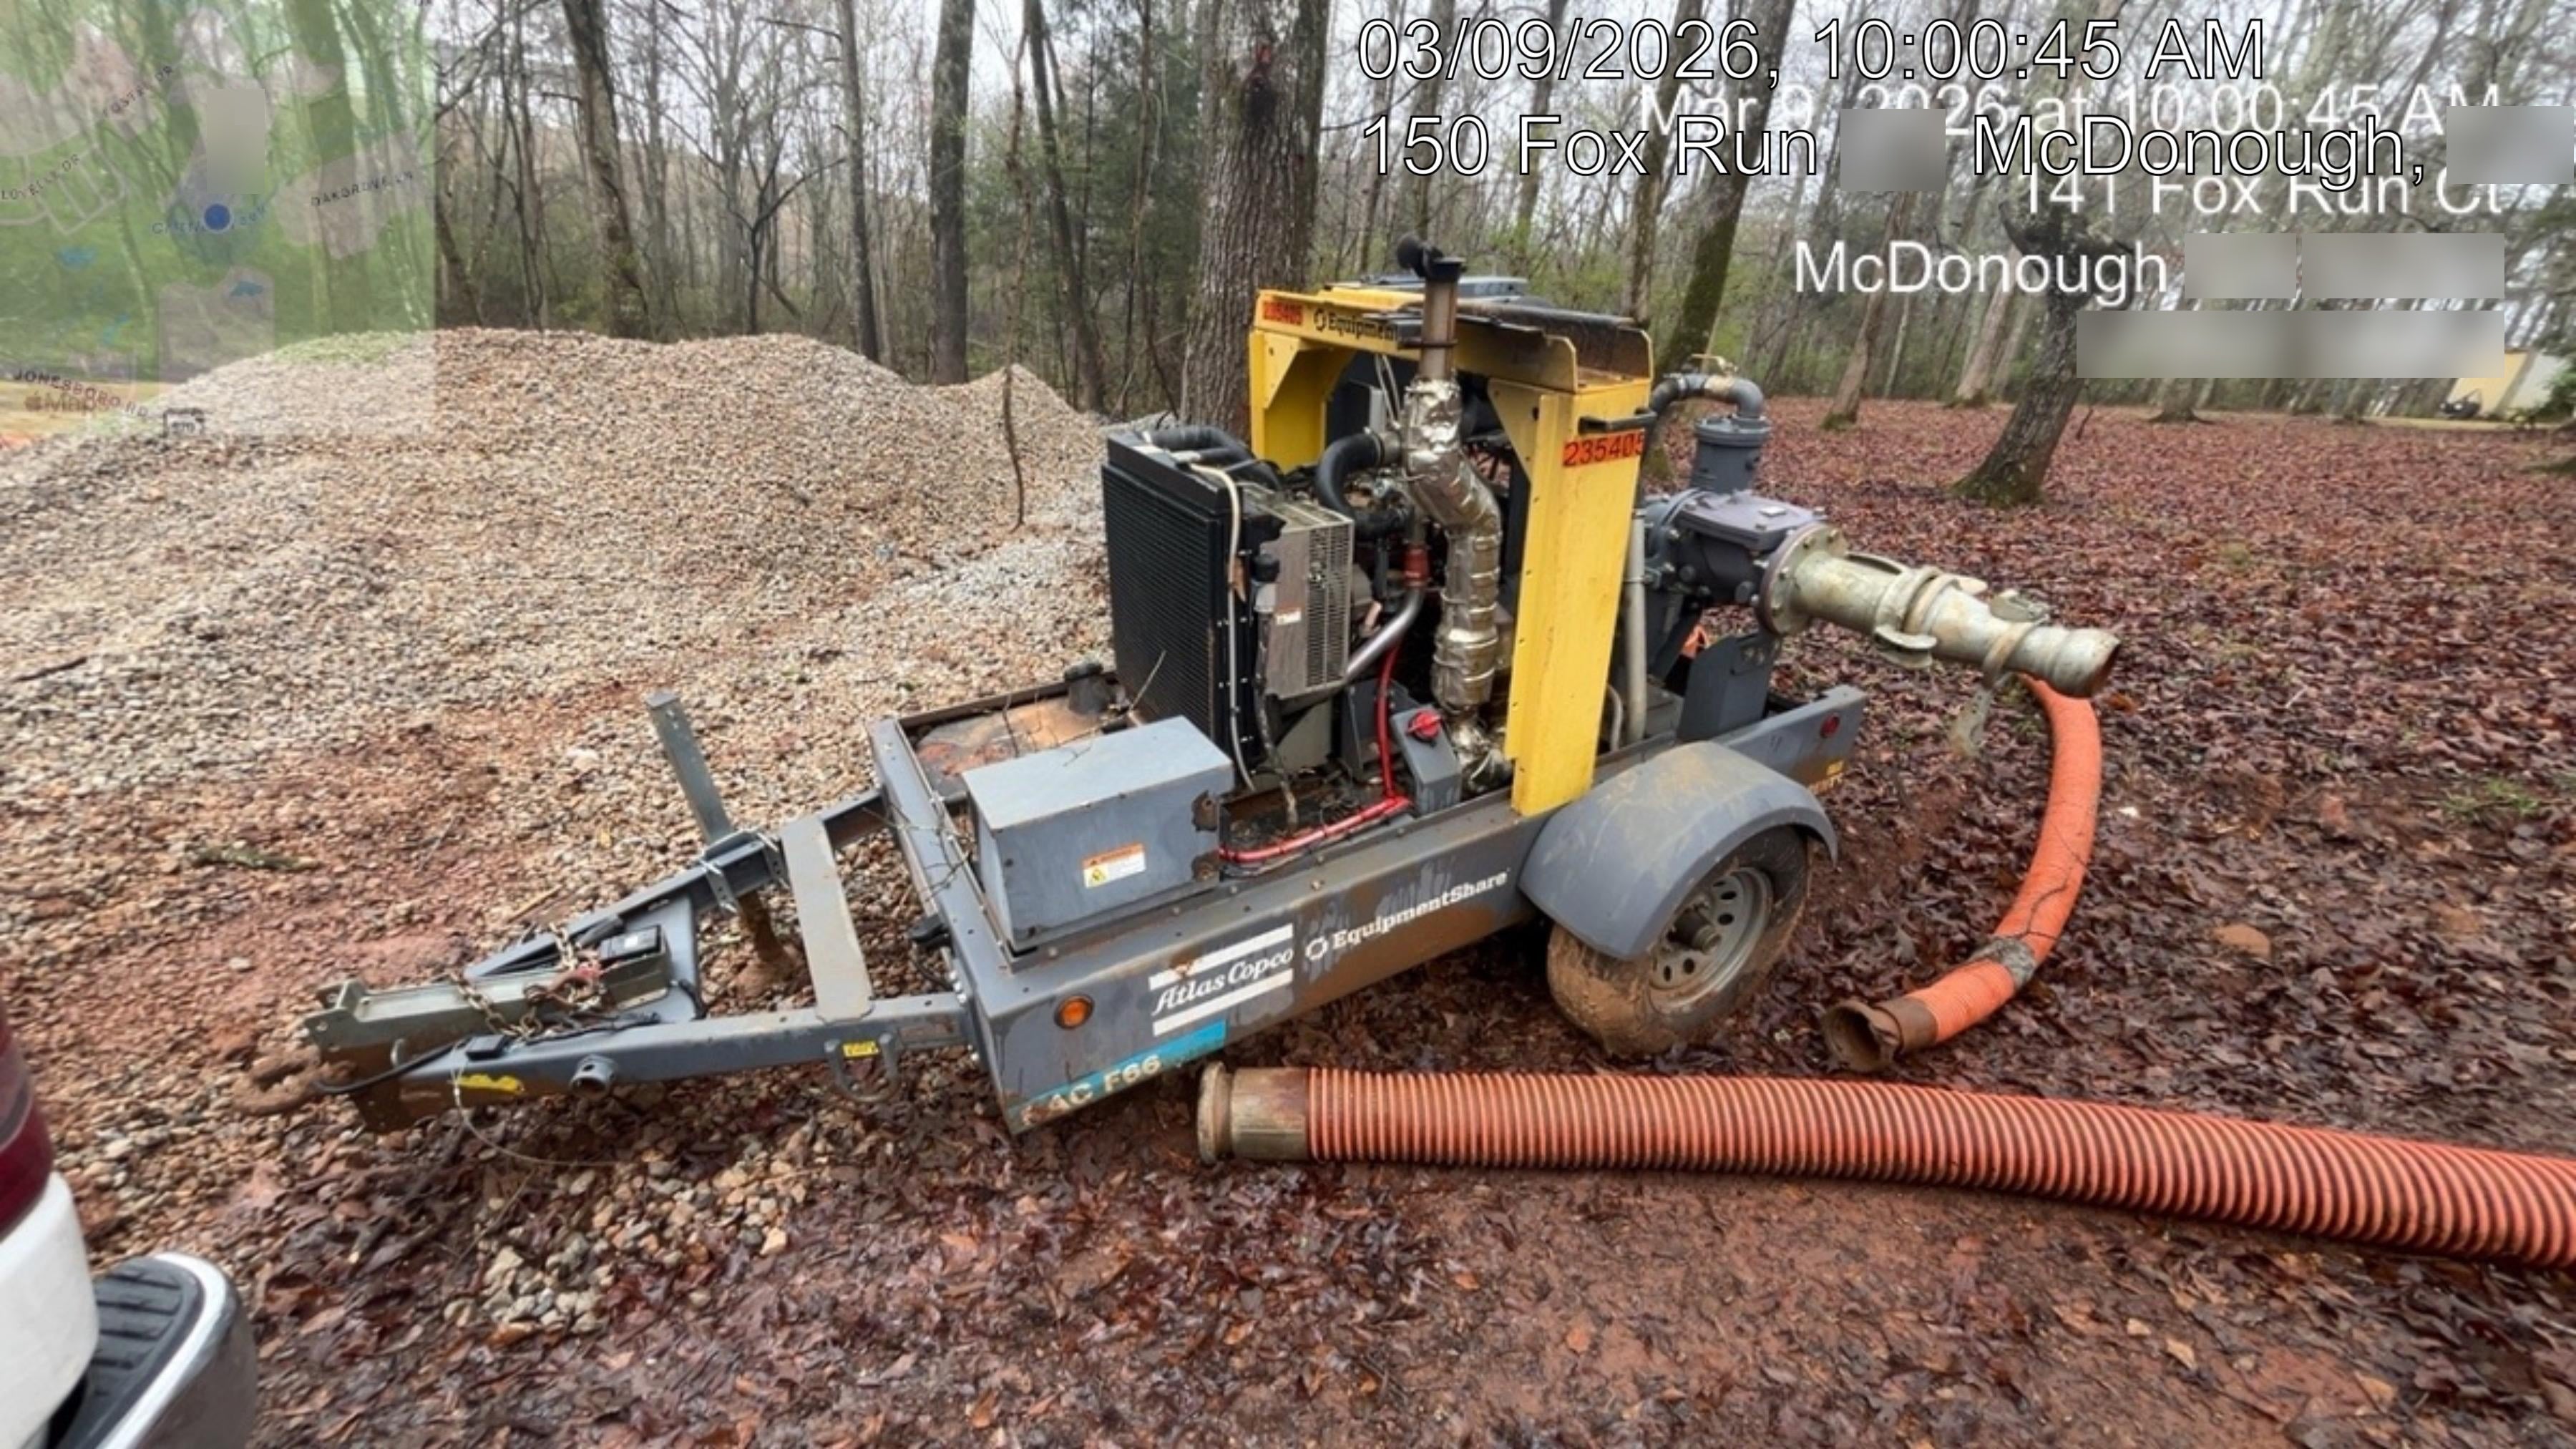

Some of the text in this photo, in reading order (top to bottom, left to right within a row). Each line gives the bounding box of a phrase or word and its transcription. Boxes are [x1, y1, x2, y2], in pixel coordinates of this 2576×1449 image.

[1563, 432, 1645, 467] 235405
[1332, 870, 1508, 950] EquipmentShare
[1151, 947, 1294, 1017] Atlas Copco
[1103, 1053, 1161, 1094] F66
